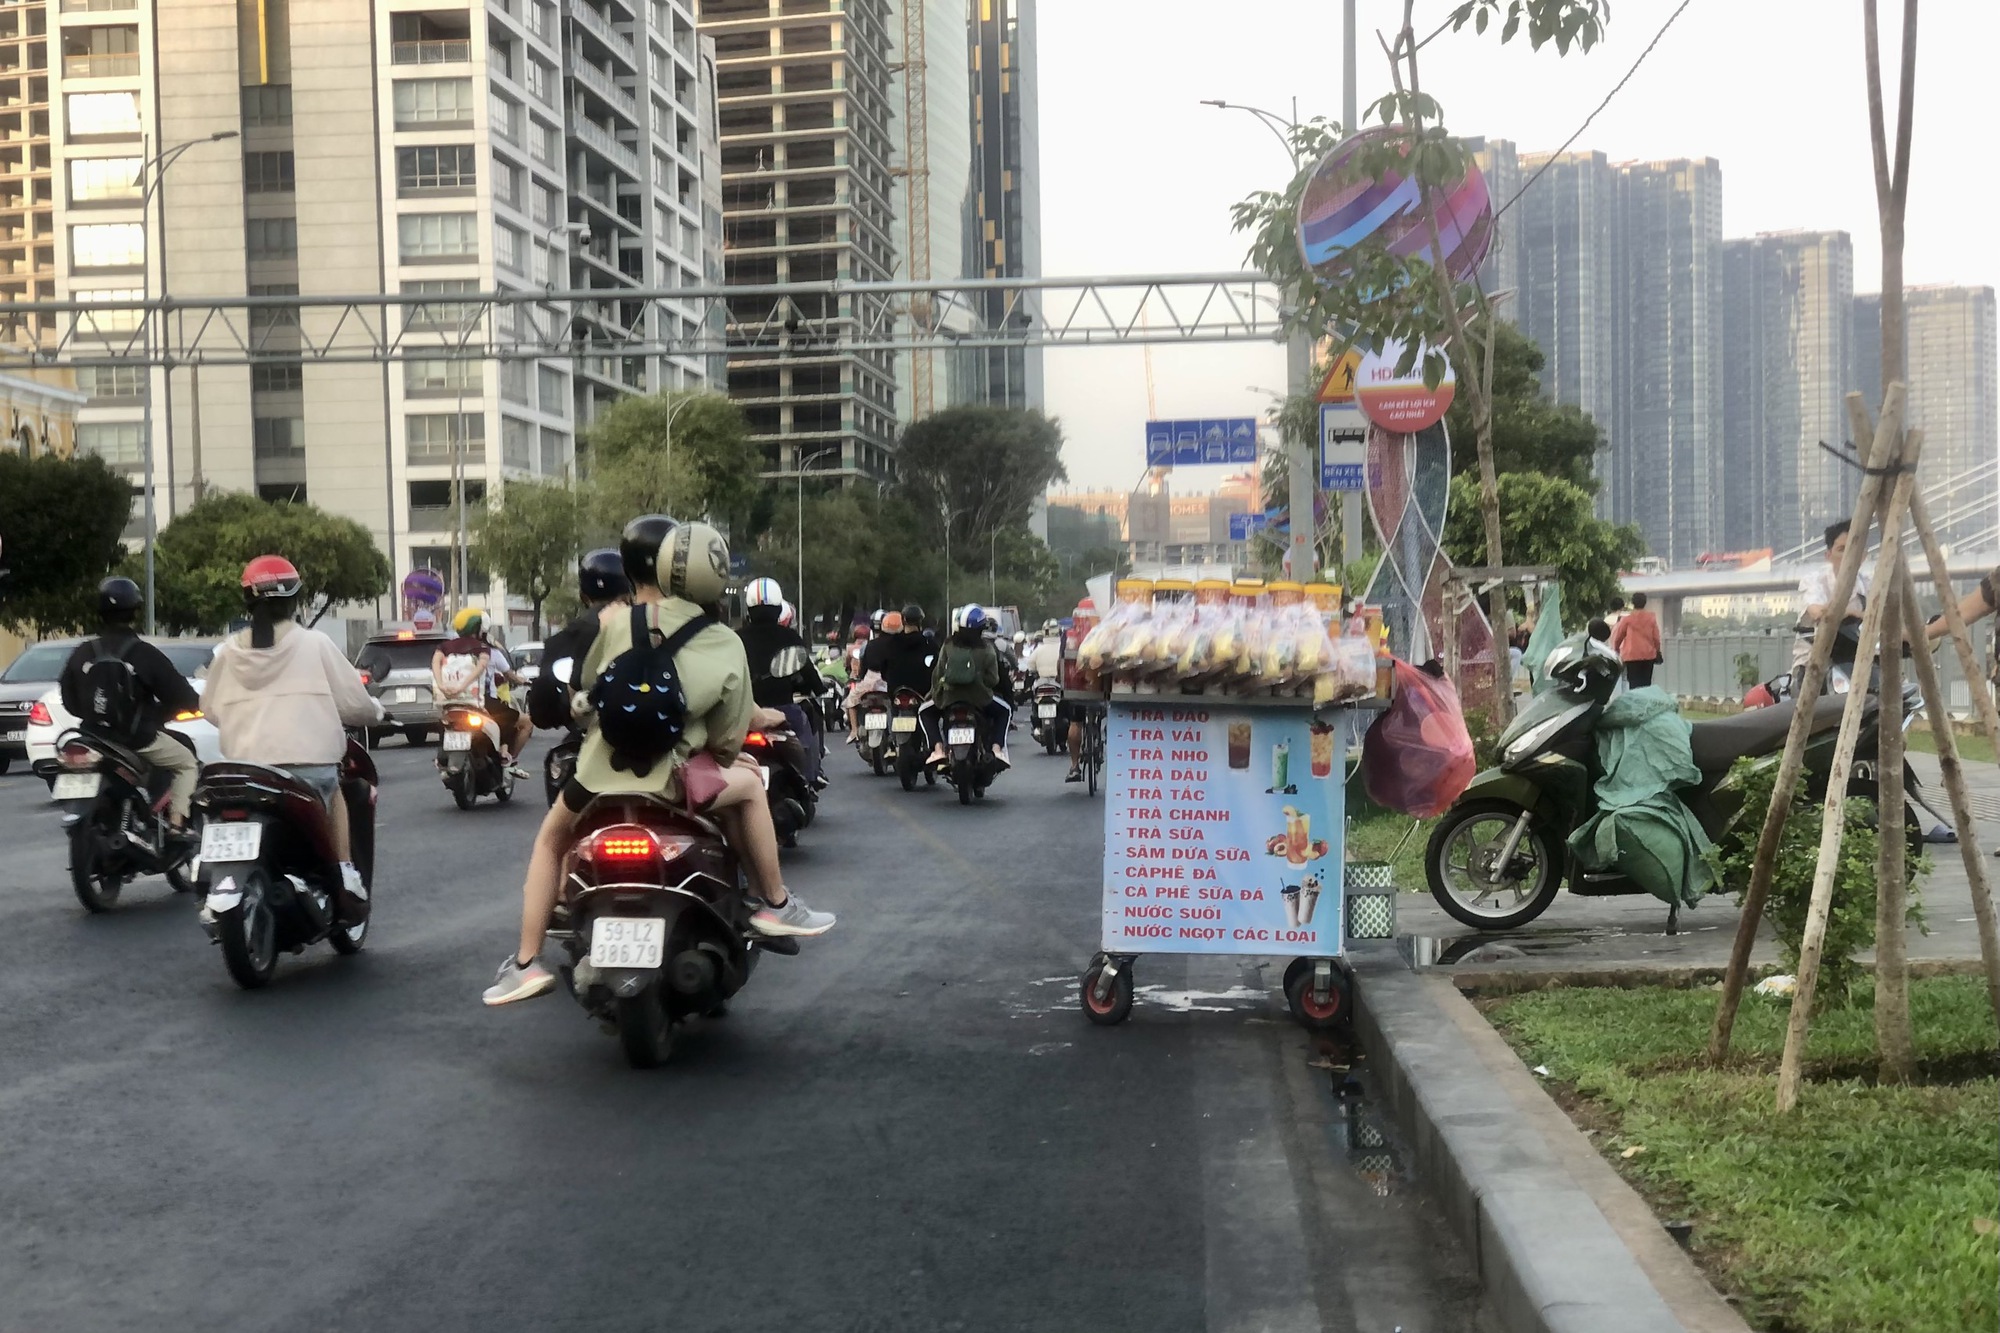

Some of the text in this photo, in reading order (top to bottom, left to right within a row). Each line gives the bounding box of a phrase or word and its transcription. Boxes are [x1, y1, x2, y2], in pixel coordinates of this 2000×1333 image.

[1129, 727, 1164, 741] TRÀ
[1129, 747, 1209, 762] TRÀ NHO
[1129, 767, 1164, 781] TRÀ
[1128, 785, 1205, 801] TRÀ TẮC
[1128, 806, 1230, 822] TRÀ CHANH
[1127, 826, 1205, 841] TRÀ SỮA
[1126, 844, 1166, 859] SÂM
[1215, 846, 1252, 863] SỮA
[1192, 866, 1217, 880] ĐÁ
[1124, 885, 1265, 902] CÀ PHÊ SỮA ĐÁ
[1124, 905, 1221, 920] NƯỚC SUỐI
[604, 922, 653, 942] 59-L2
[1123, 924, 1317, 944] NƯỚC NGỌT CÁC LOẠI
[596, 944, 657, 964] 386.79
